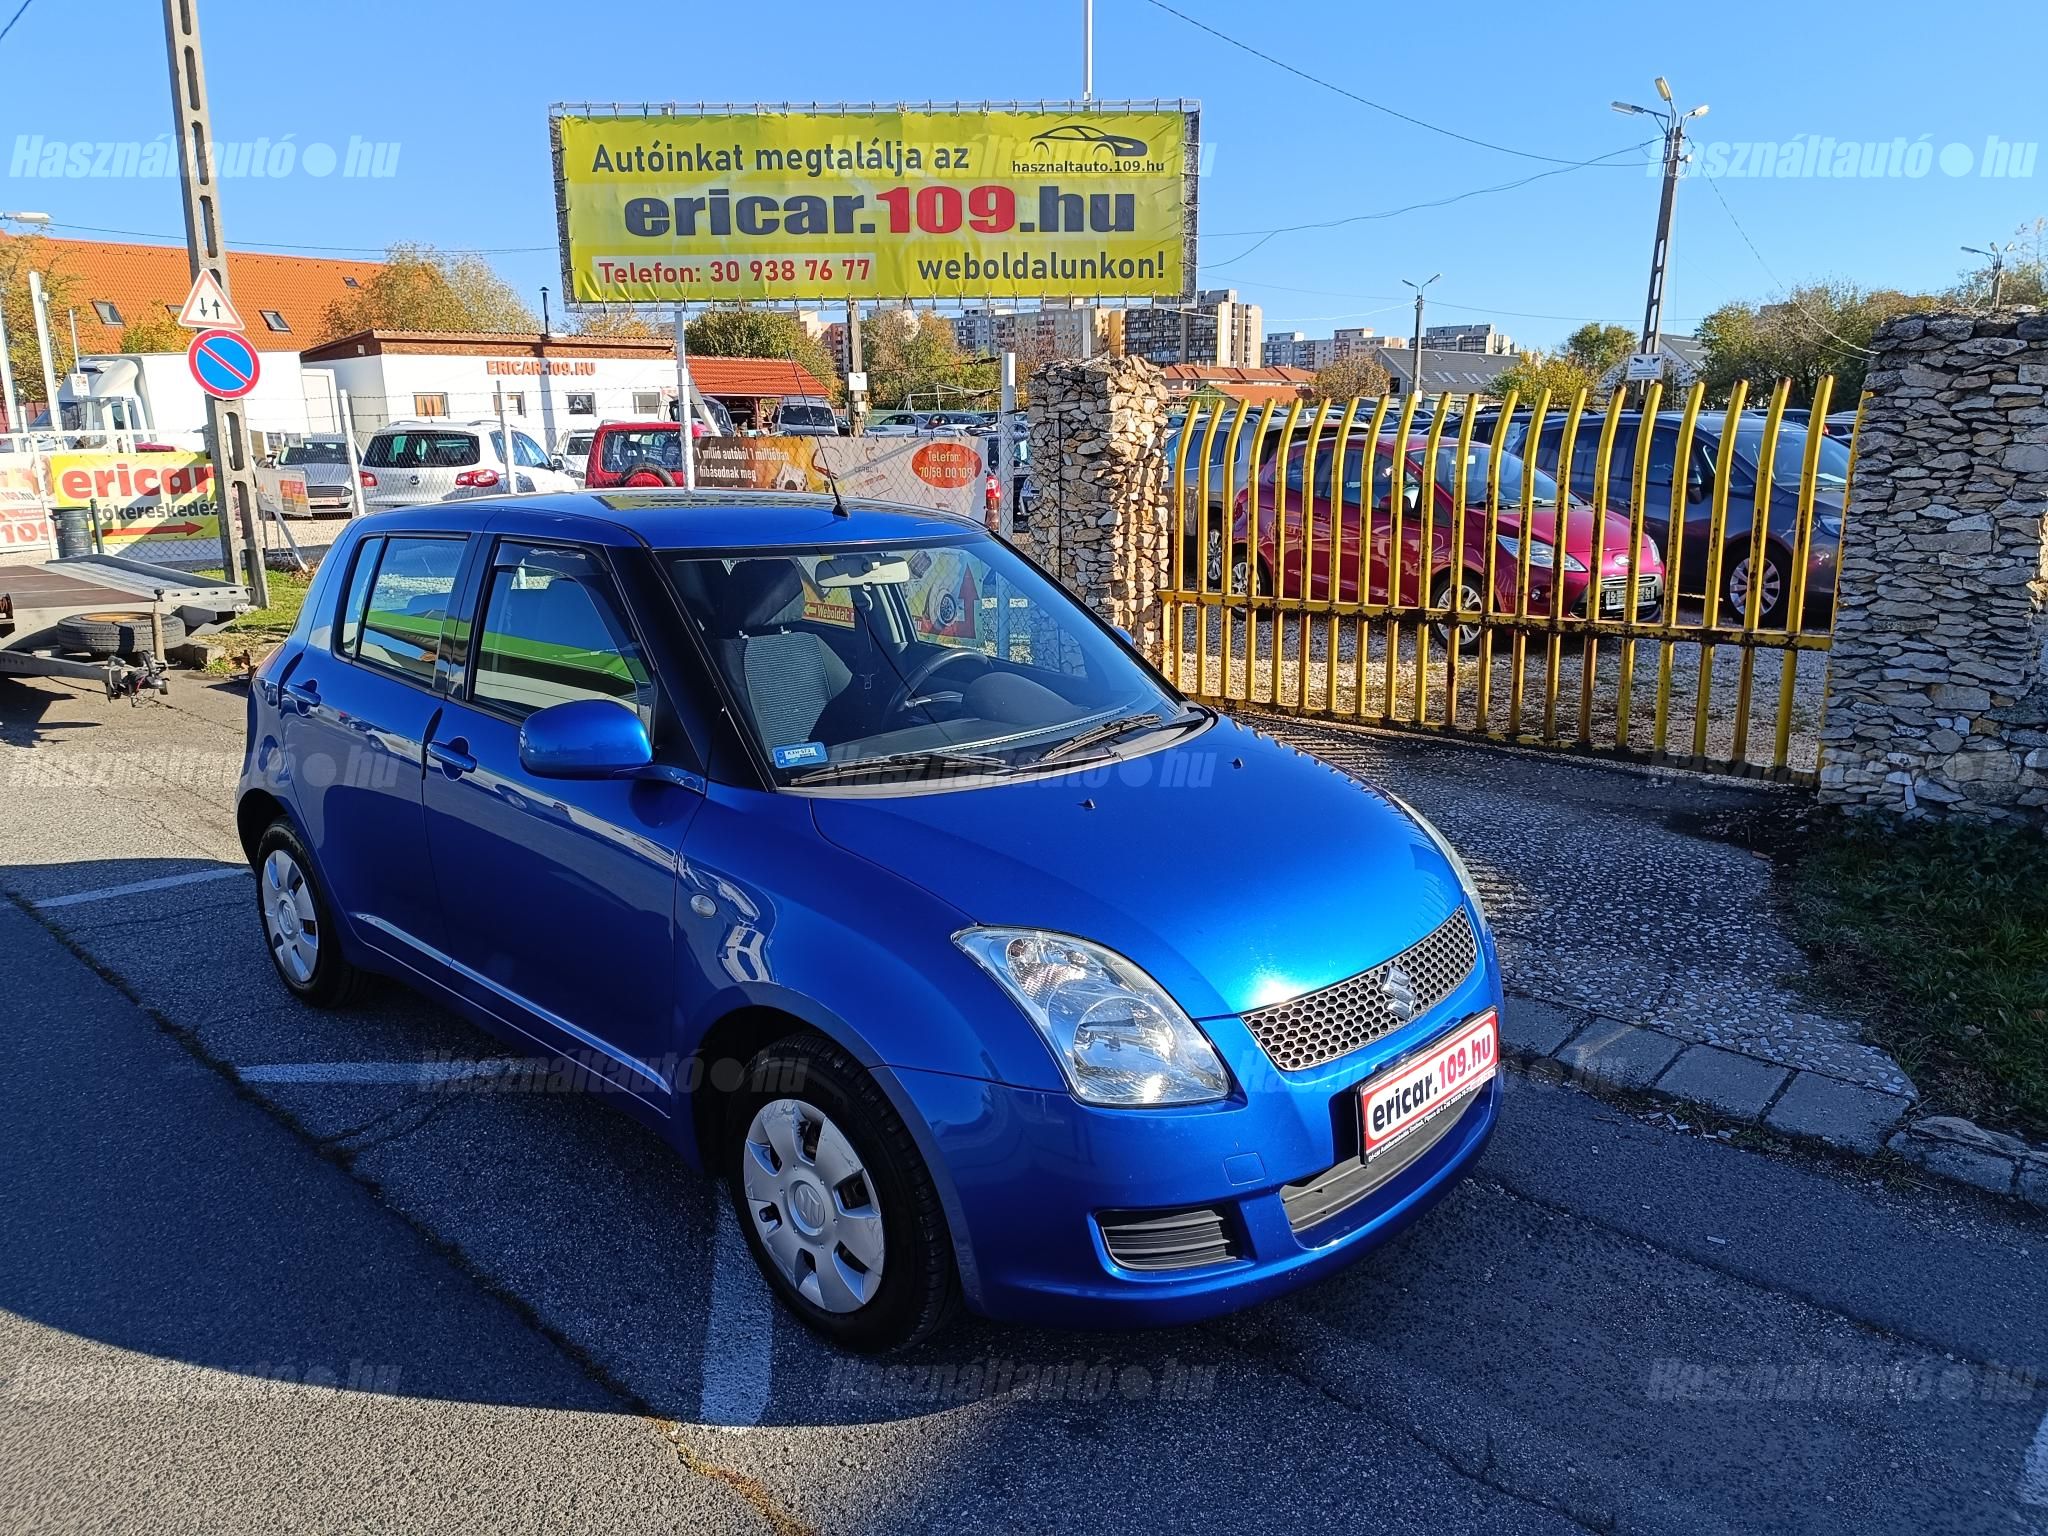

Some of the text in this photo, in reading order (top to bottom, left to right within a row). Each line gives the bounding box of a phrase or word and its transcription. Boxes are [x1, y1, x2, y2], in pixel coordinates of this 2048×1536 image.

[592, 137, 969, 177] Autóinkat megtalálja az
[1012, 160, 1165, 173] hasznaltauto.109.hu
[624, 185, 1135, 237] ericar.109.hu
[598, 258, 870, 285] Telefon: 30 938 76 77
[917, 251, 1165, 281] weboldalunkon!
[486, 361, 596, 376] ERICAR.109.HU
[62, 464, 215, 499] ericar
[741, 470, 757, 482] meg
[87, 500, 219, 521] tókereskedés
[1373, 1034, 1491, 1133] ericar.109.hu
